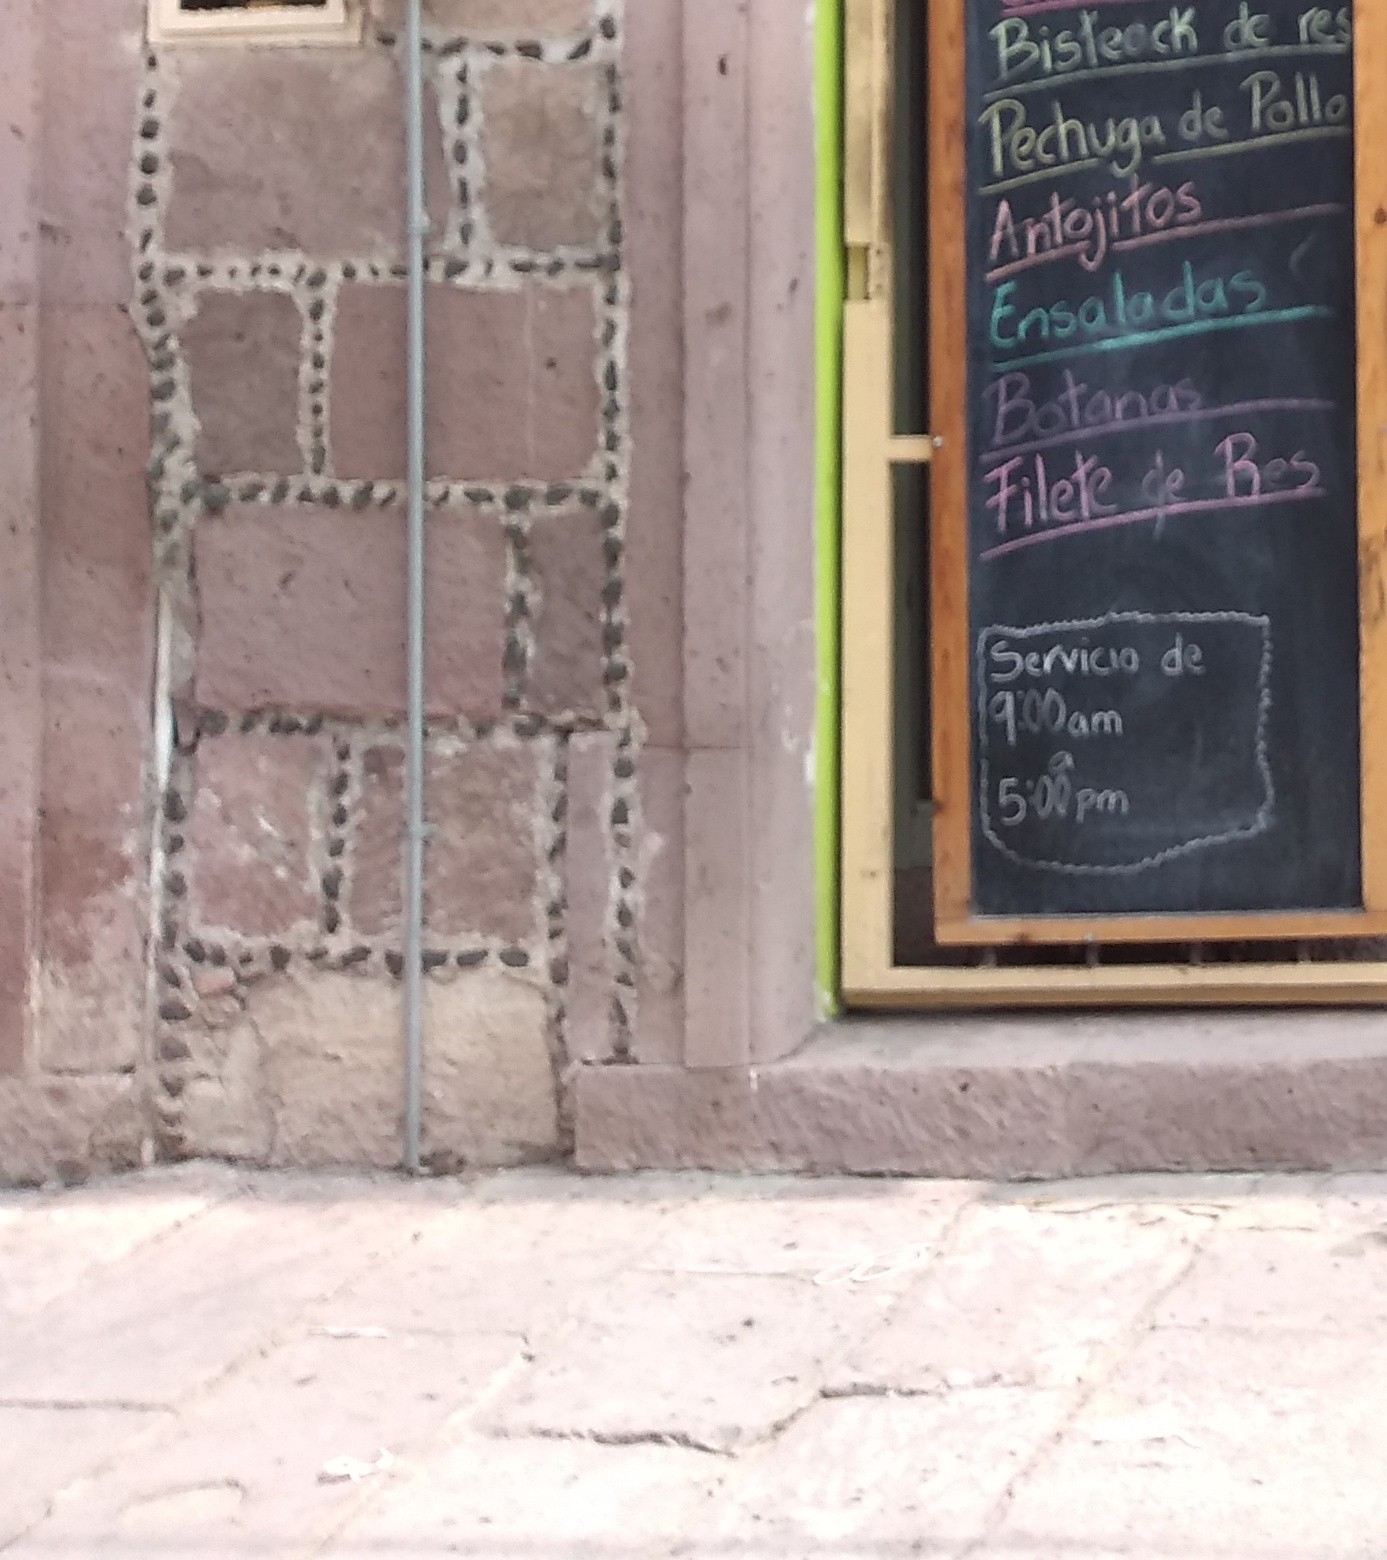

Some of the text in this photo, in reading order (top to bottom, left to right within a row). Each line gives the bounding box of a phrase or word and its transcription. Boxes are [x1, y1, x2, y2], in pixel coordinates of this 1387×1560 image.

[1223, 1, 1270, 49] de
[1297, 5, 1351, 43] res
[978, 70, 1349, 178] Pechuga de Pollo
[988, 173, 1200, 272] Antojitos
[989, 259, 1267, 349] Ensaladas
[984, 450, 1117, 532] Filete
[1215, 432, 1321, 498] Res
[1161, 632, 1206, 678] de
